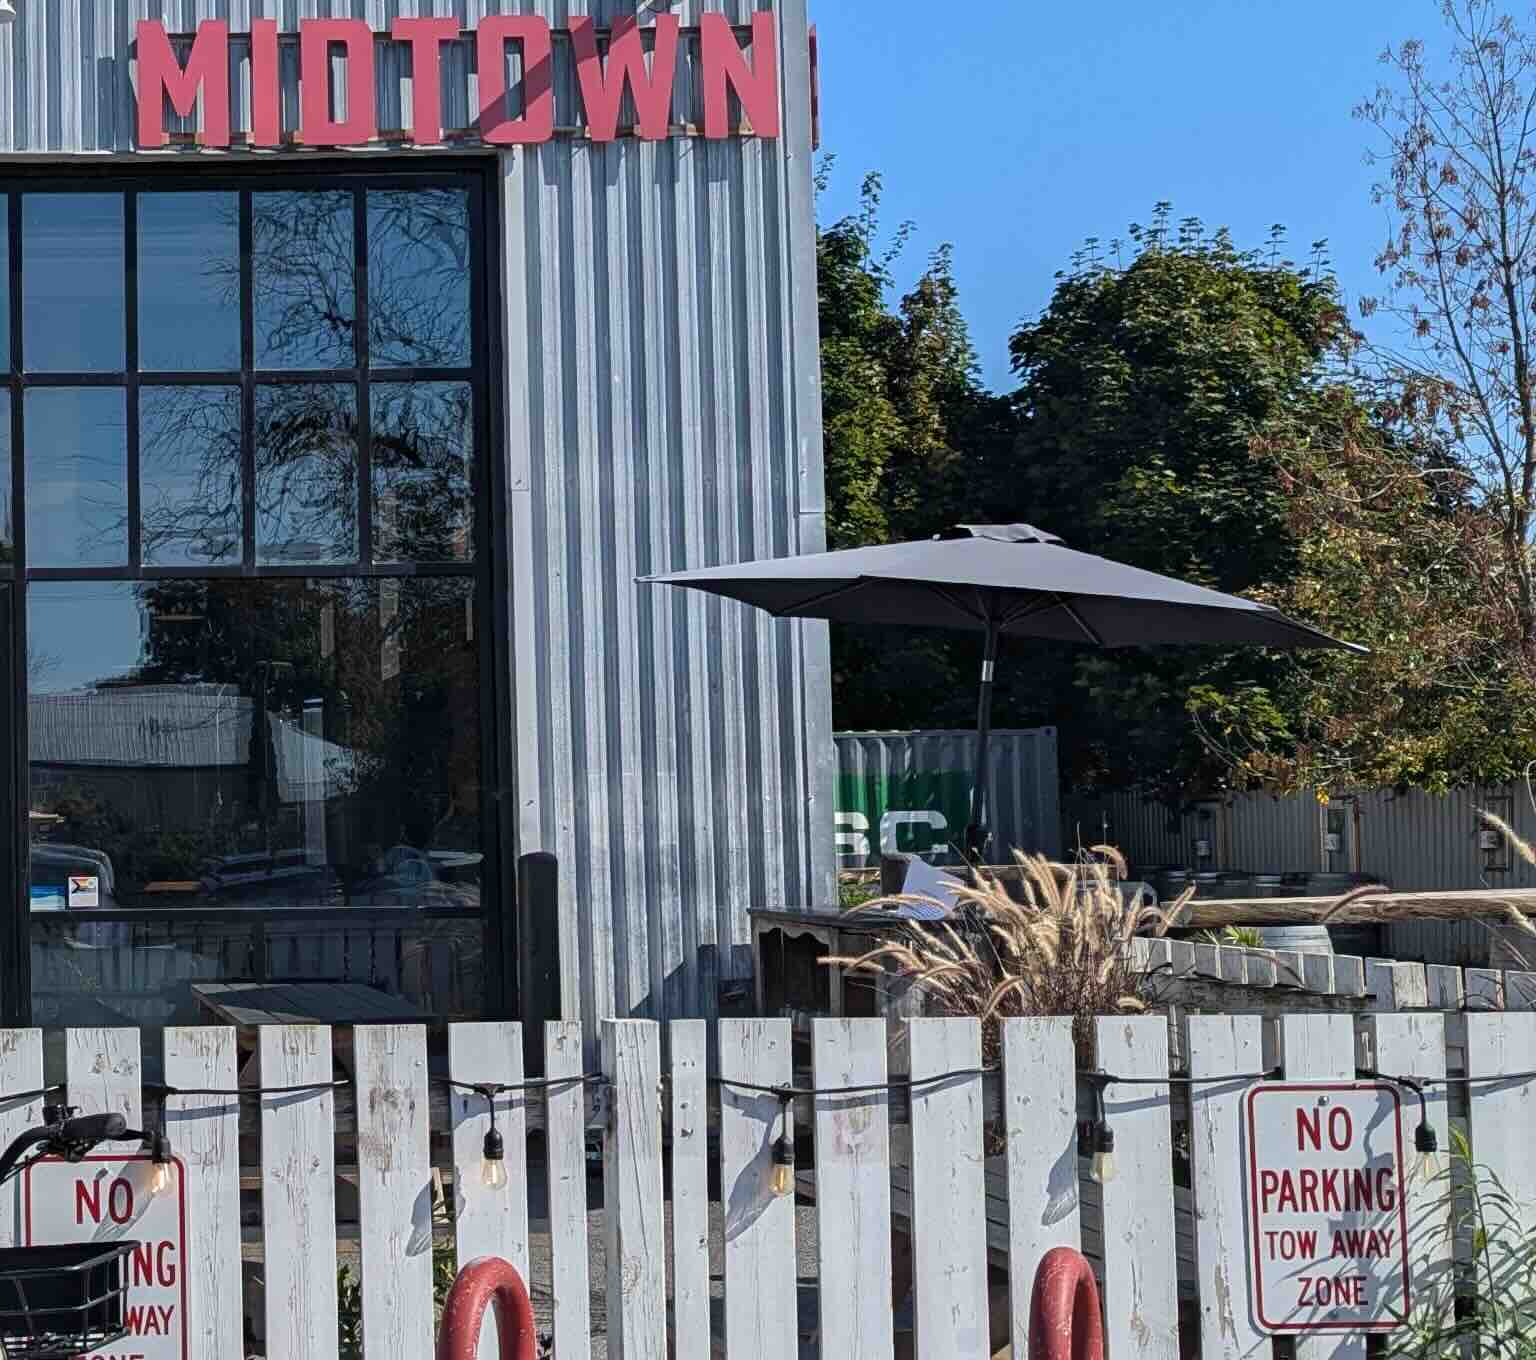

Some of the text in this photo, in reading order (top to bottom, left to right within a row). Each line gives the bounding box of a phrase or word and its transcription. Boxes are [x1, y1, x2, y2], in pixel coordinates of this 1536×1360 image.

[135, 11, 779, 149] MIDTOWN
[1296, 1106, 1353, 1152] NO
[74, 1176, 135, 1225] NO
[1260, 1167, 1396, 1214] PARKING
[1264, 1229, 1395, 1260] TOW AWAY
[1297, 1276, 1369, 1307] ZONE
[123, 1304, 175, 1337] WAY
